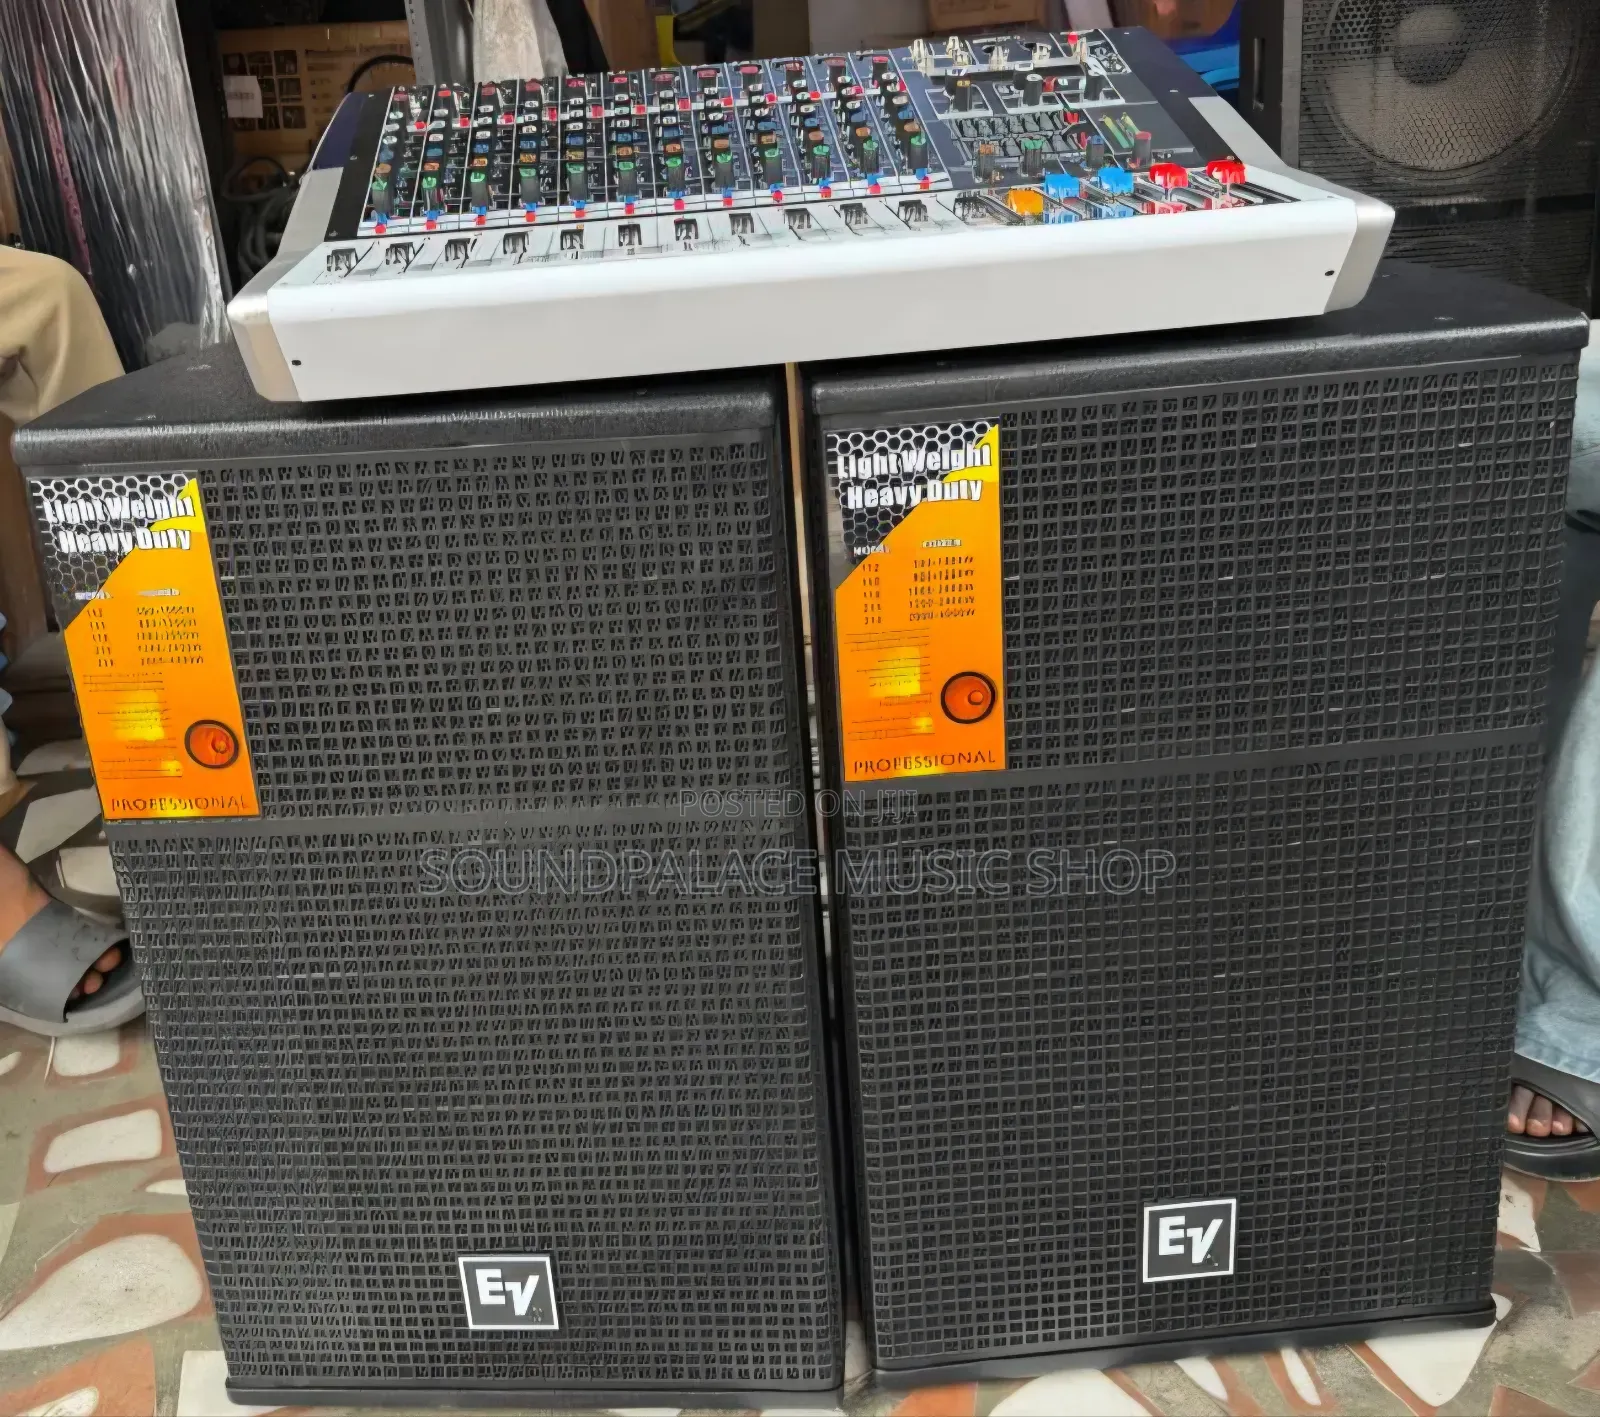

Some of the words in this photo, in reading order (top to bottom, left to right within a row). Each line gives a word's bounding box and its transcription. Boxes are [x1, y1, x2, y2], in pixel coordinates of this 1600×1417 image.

[847, 483, 922, 509] Heavy
[926, 478, 983, 502] Duty
[853, 750, 997, 775] PROFESSIONAL
